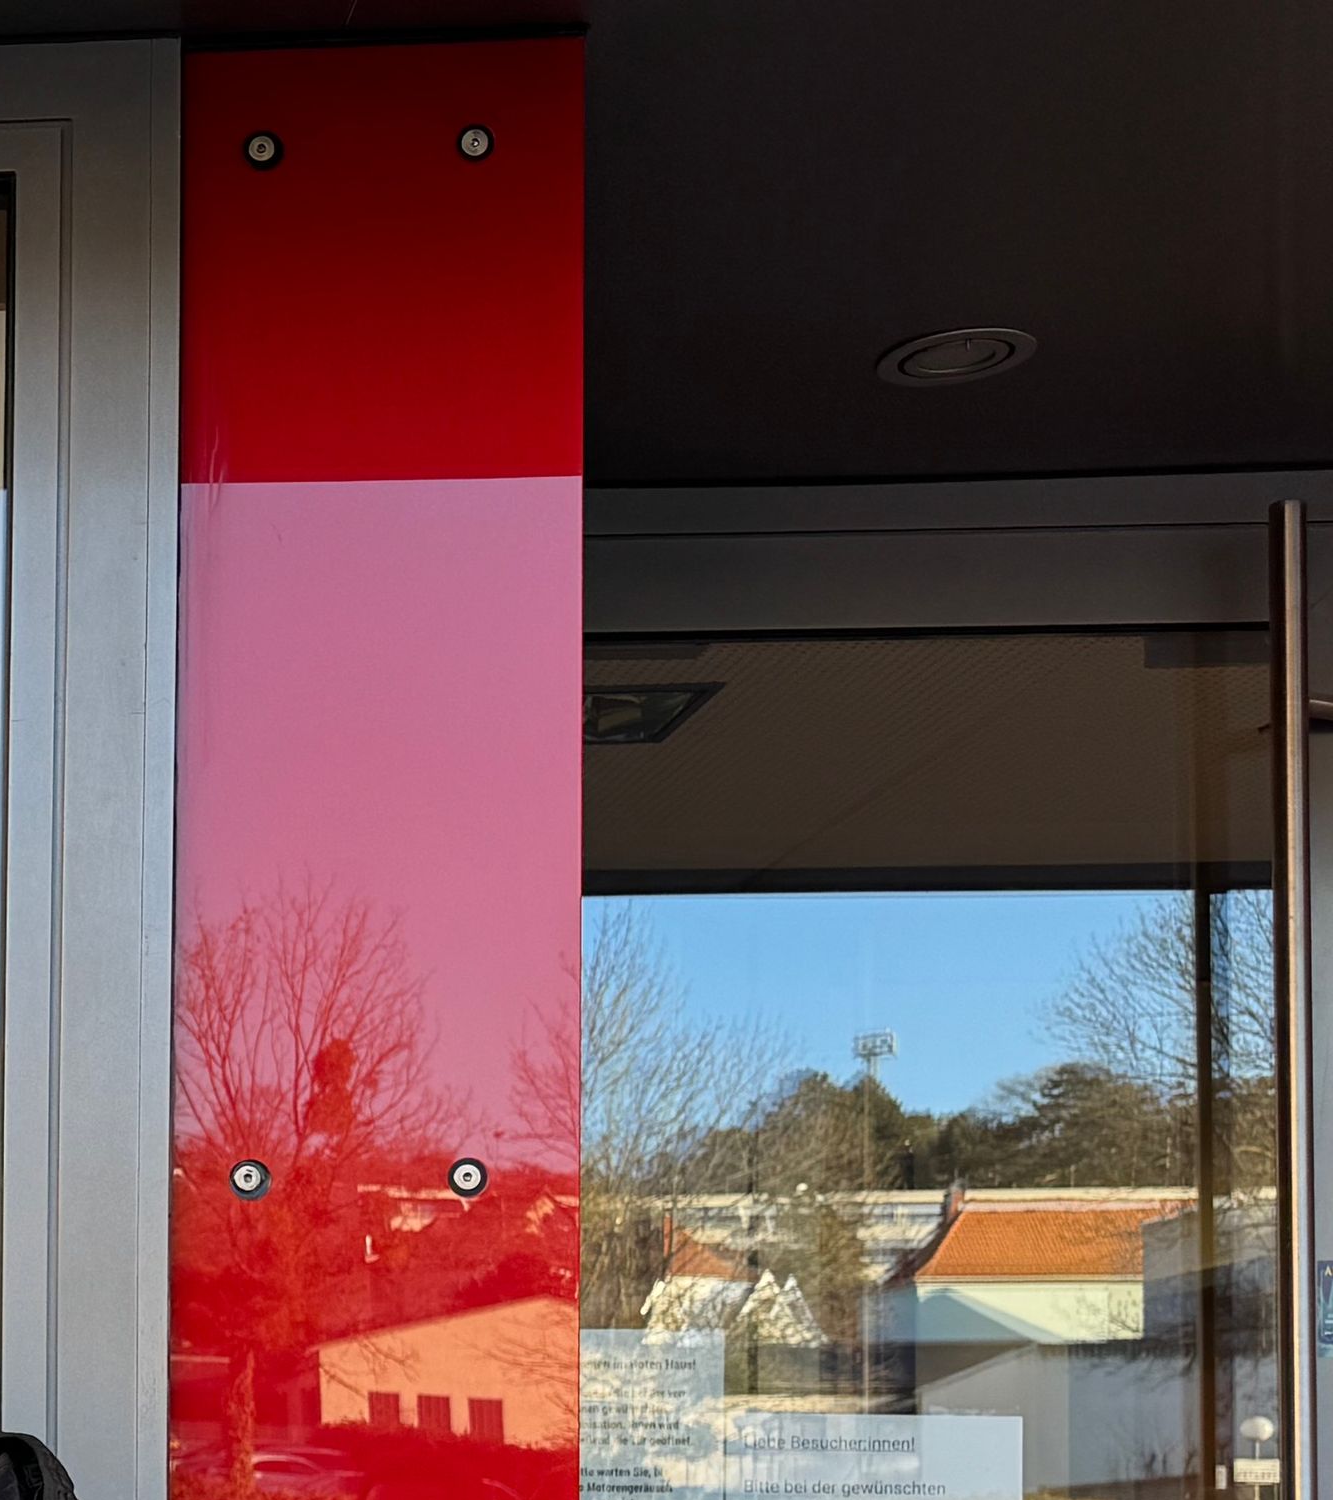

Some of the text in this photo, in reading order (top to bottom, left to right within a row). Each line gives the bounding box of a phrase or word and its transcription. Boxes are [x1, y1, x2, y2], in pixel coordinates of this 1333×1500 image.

[743, 1479, 947, 1499] Bitte bei der gewünschten
